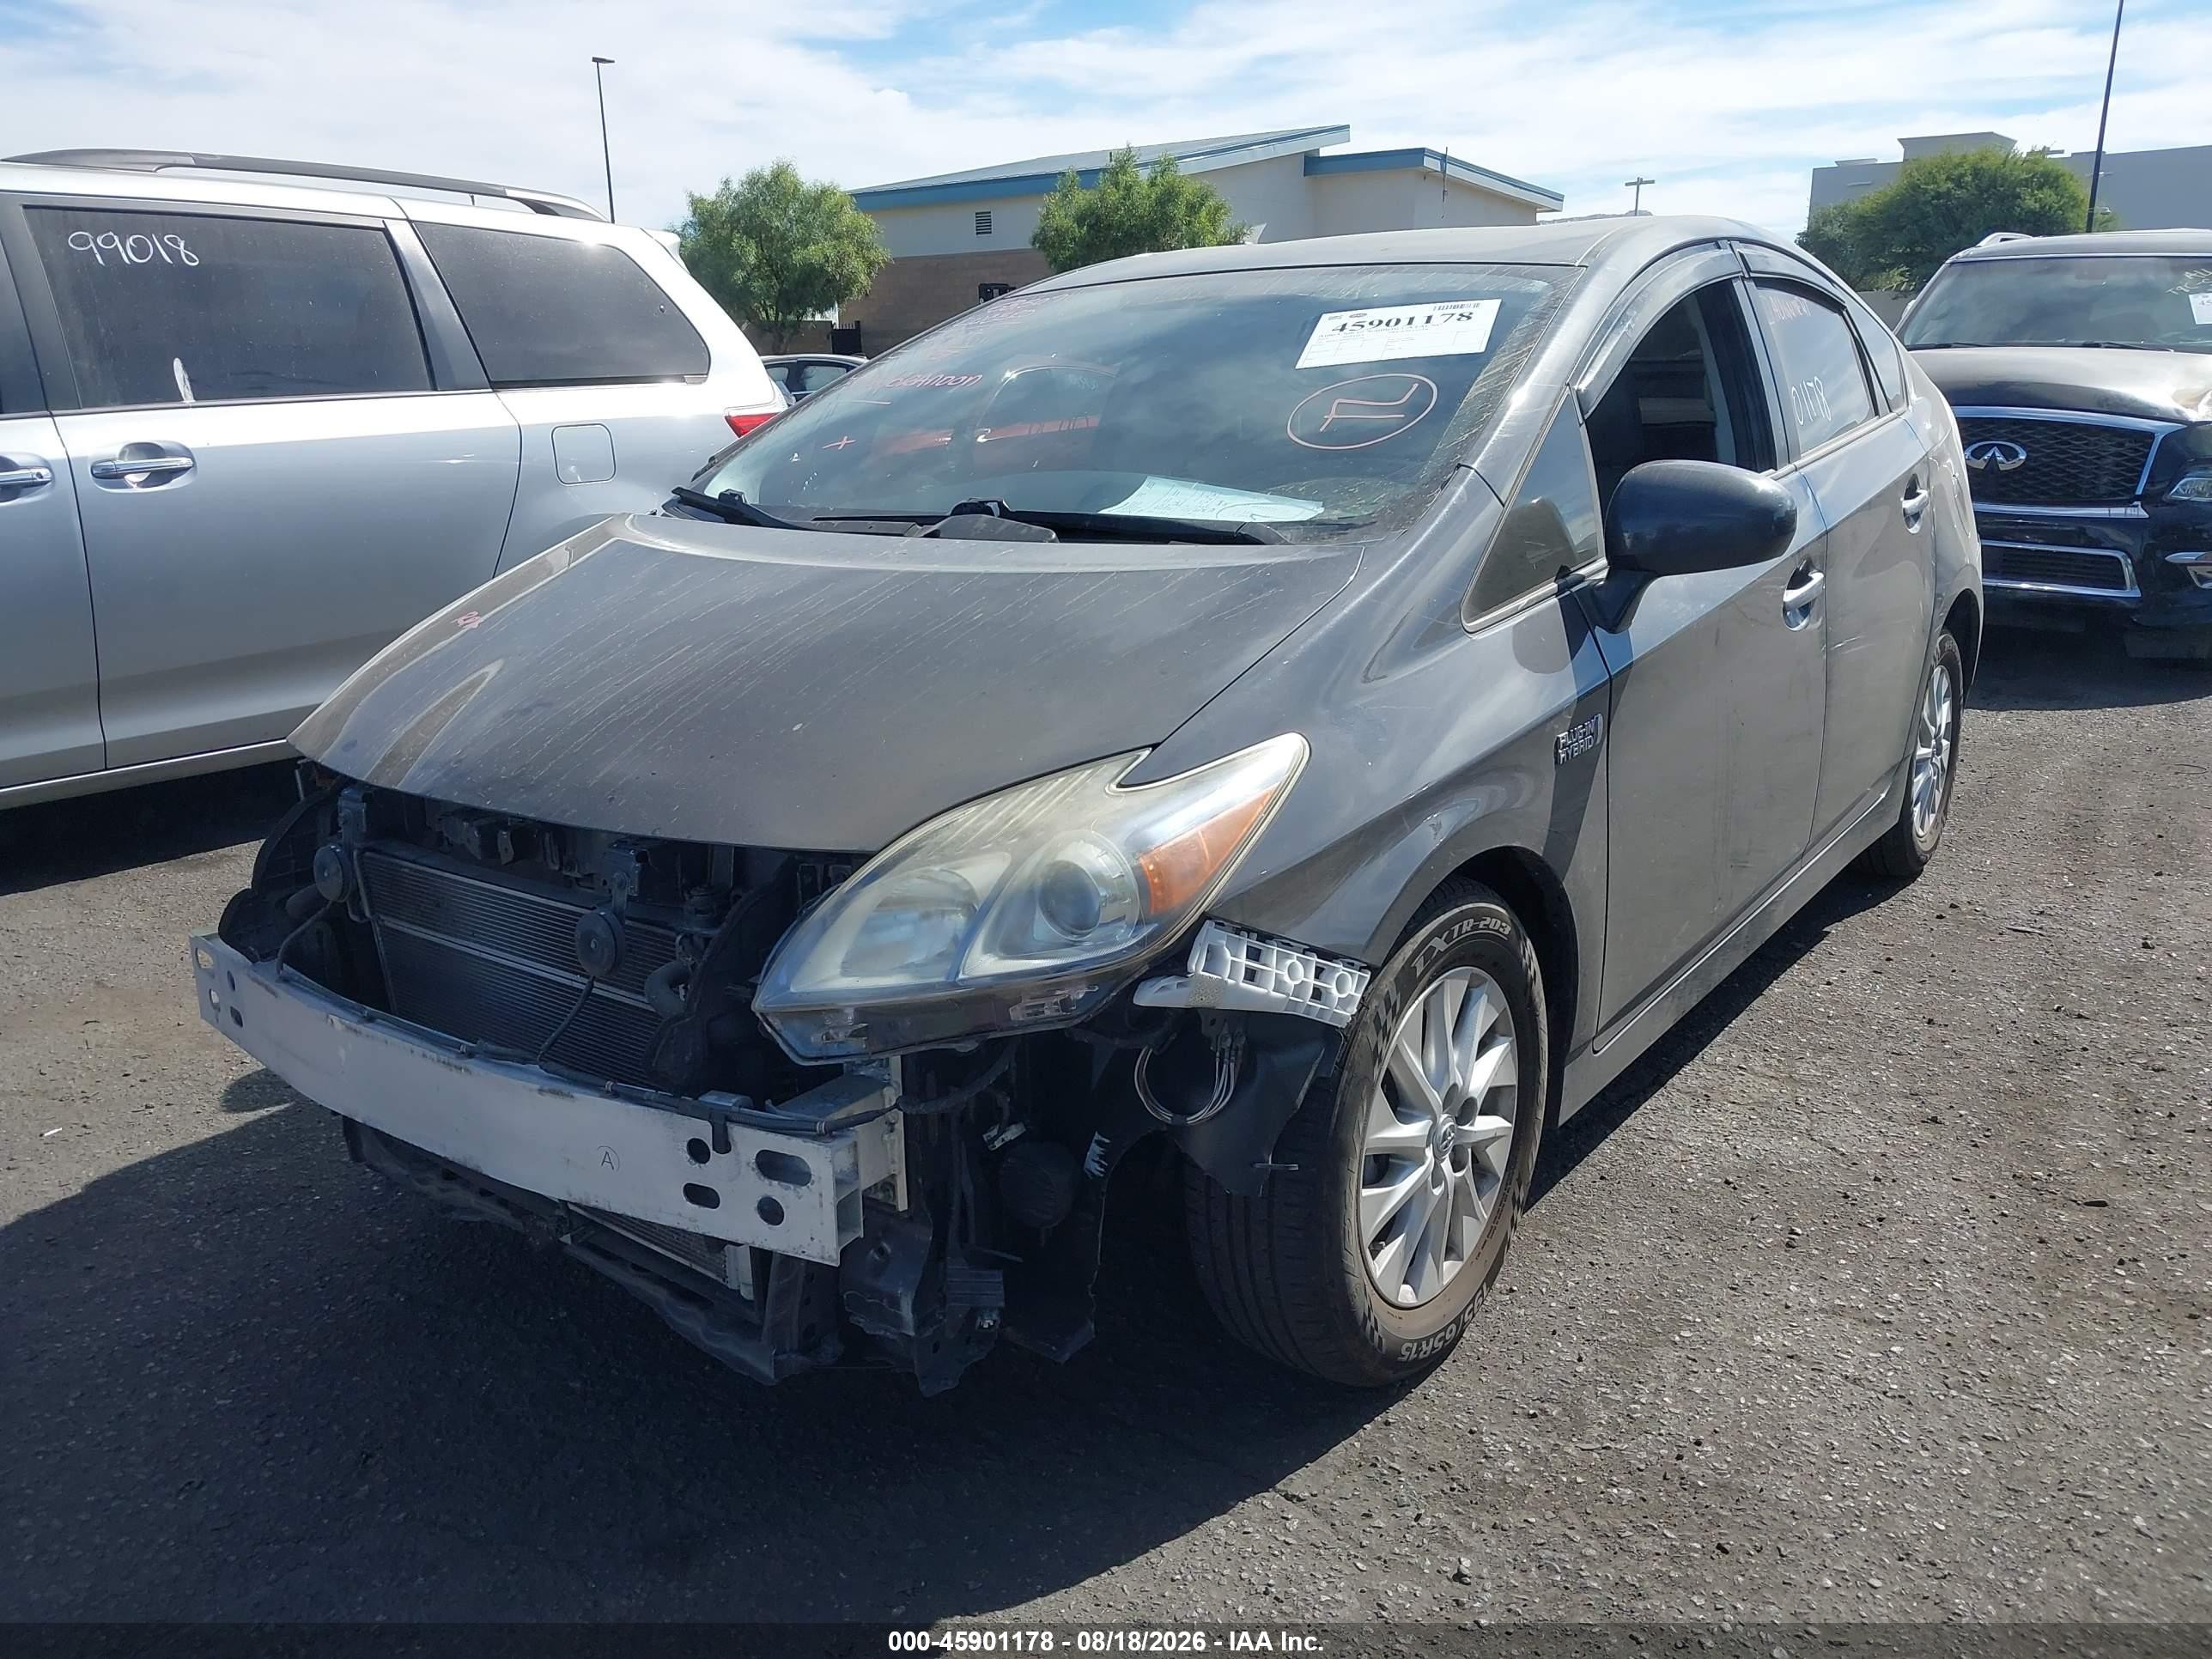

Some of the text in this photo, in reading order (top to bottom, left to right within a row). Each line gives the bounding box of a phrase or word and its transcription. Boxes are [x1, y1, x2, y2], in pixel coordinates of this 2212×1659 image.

[68, 231, 200, 266] 99018
[1332, 312, 1474, 332] 45901178
[1791, 375, 1832, 426] 01178
[1558, 734, 1595, 765] HYBRID
[601, 1151, 615, 1170] A
[1397, 1281, 1491, 1362] 195/65R15
